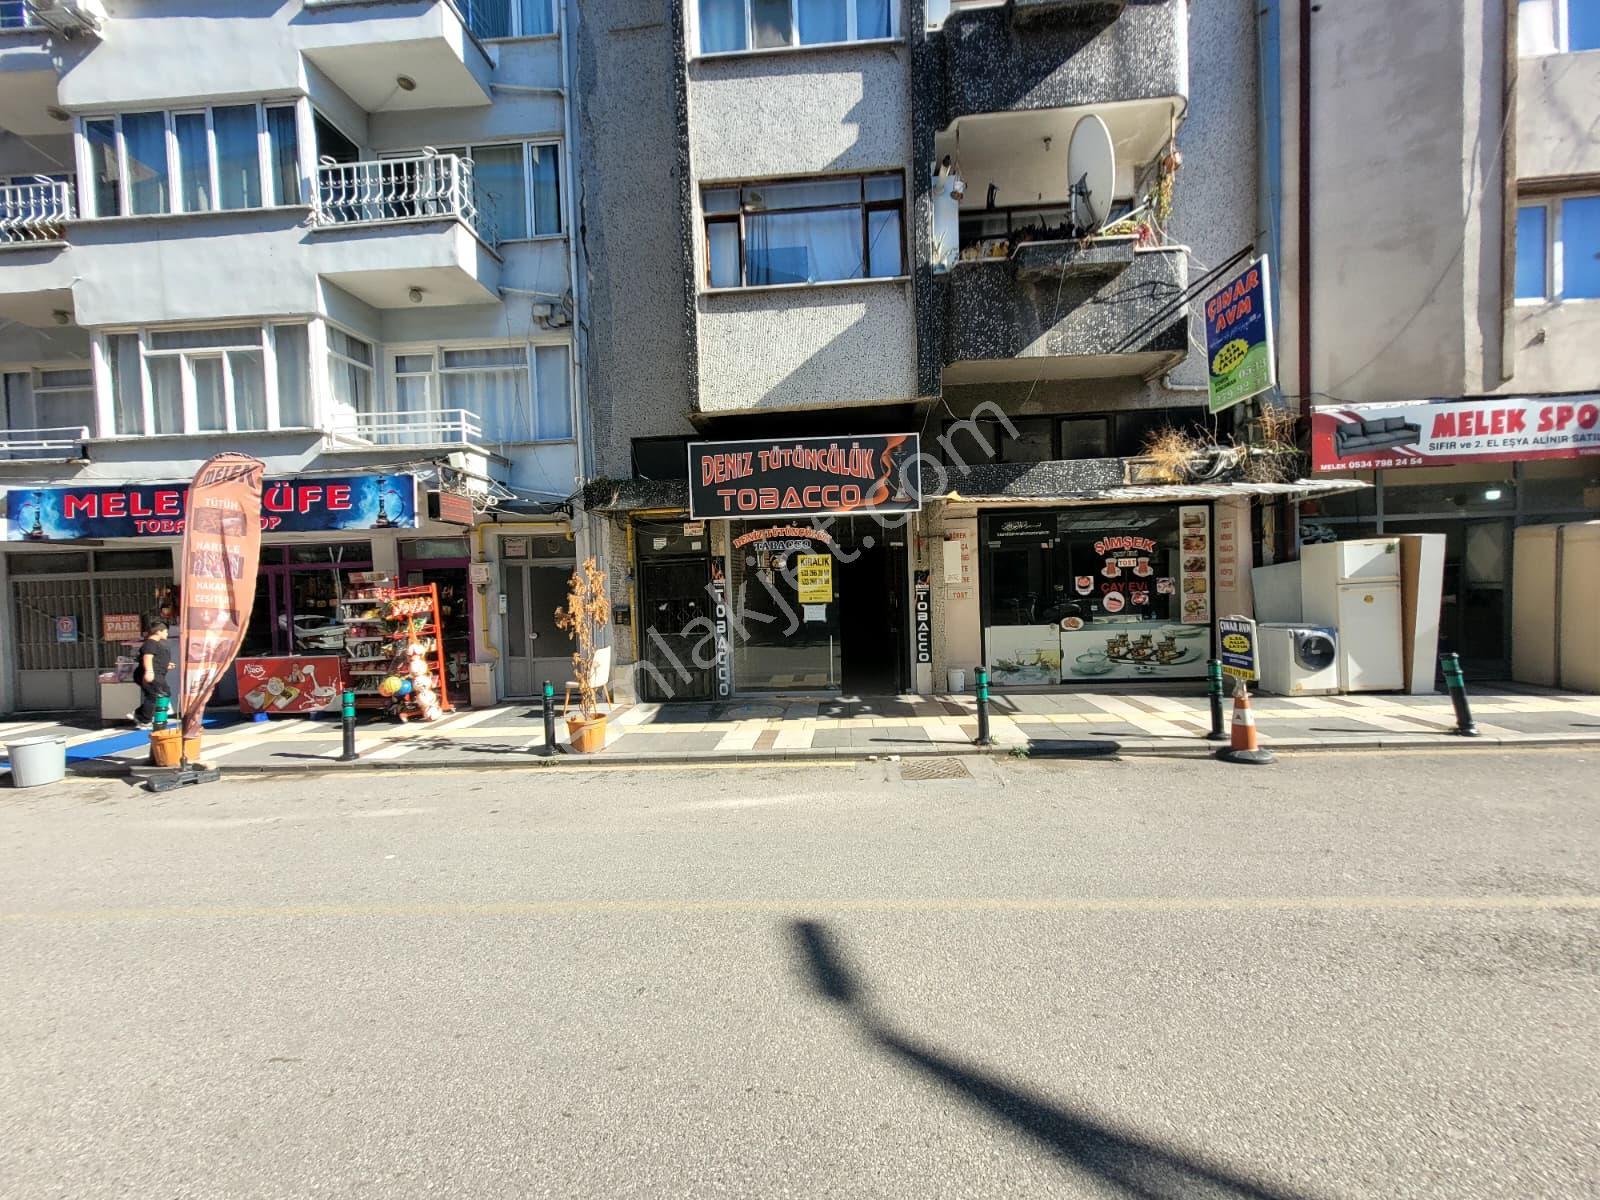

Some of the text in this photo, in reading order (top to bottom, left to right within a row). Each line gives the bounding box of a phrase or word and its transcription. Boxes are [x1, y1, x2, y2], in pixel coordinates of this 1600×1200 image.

[1207, 269, 1259, 322] ÇINAR
[1215, 295, 1252, 334] AVM
[1431, 409, 1527, 438] MELEK
[758, 442, 875, 480] TÜTÜNCÜLÜK
[1428, 441, 1457, 452] SIFIR
[1474, 440, 1484, 449] 2.
[1487, 439, 1500, 448] EL
[1503, 437, 1529, 449] EŞYA
[1320, 457, 1423, 471] MELEK 0534 798 24 54
[63, 481, 352, 519] MELE ÜFE
[716, 485, 861, 511] TOBACCO
[134, 519, 186, 534] TOBA
[107, 622, 139, 632] PARK
[714, 589, 729, 696] TOBACCO
[916, 591, 930, 663] TOBACCO
